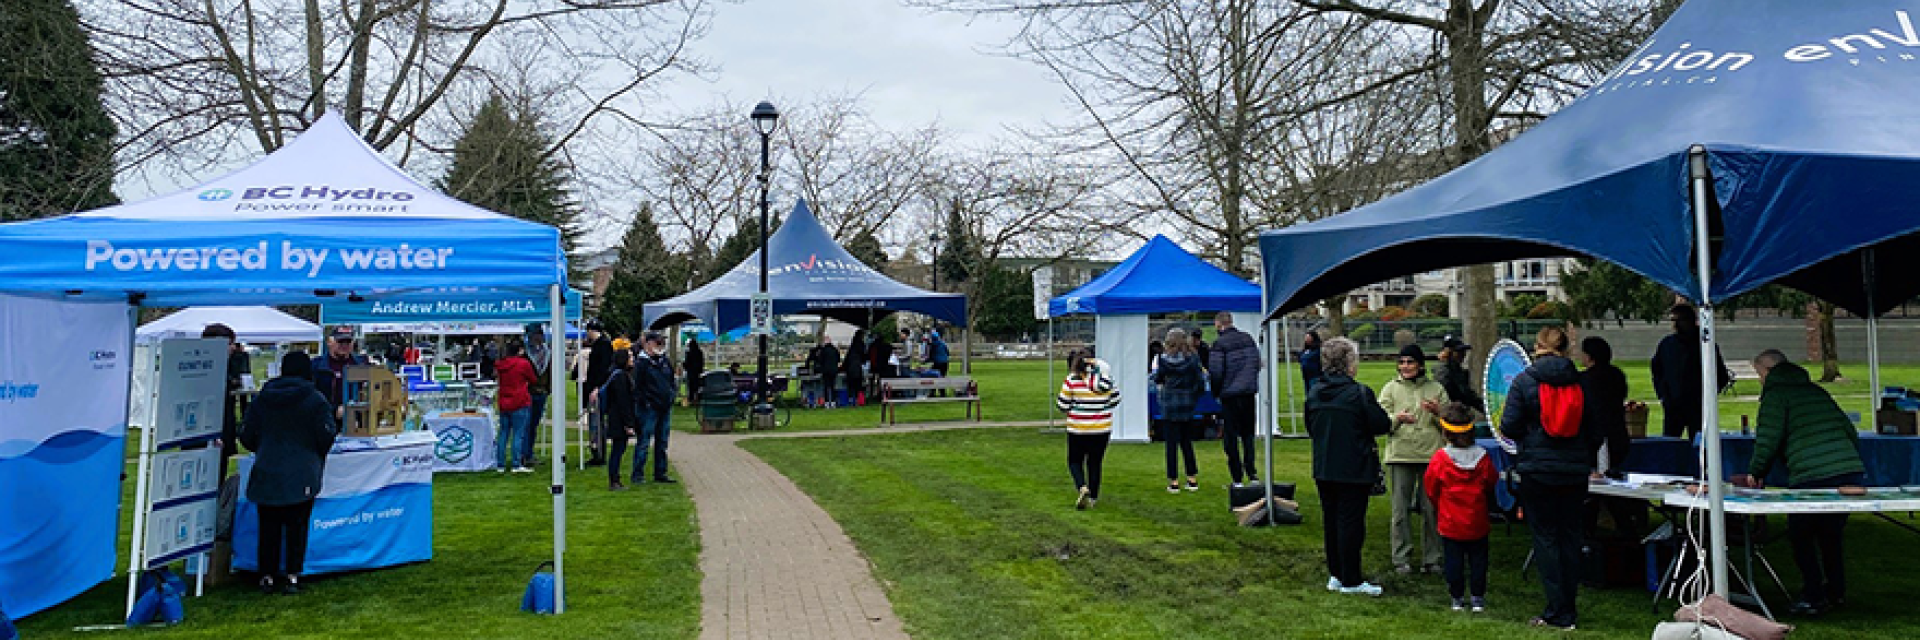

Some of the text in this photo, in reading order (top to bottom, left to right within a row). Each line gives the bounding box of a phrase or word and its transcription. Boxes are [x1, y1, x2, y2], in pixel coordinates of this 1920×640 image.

[241, 185, 415, 202] BC Hydro
[331, 203, 410, 213] smart
[85, 239, 454, 279] Powered by water
[371, 300, 536, 314] Andrew Mercier, MLA
[313, 507, 404, 531] Powered by water
